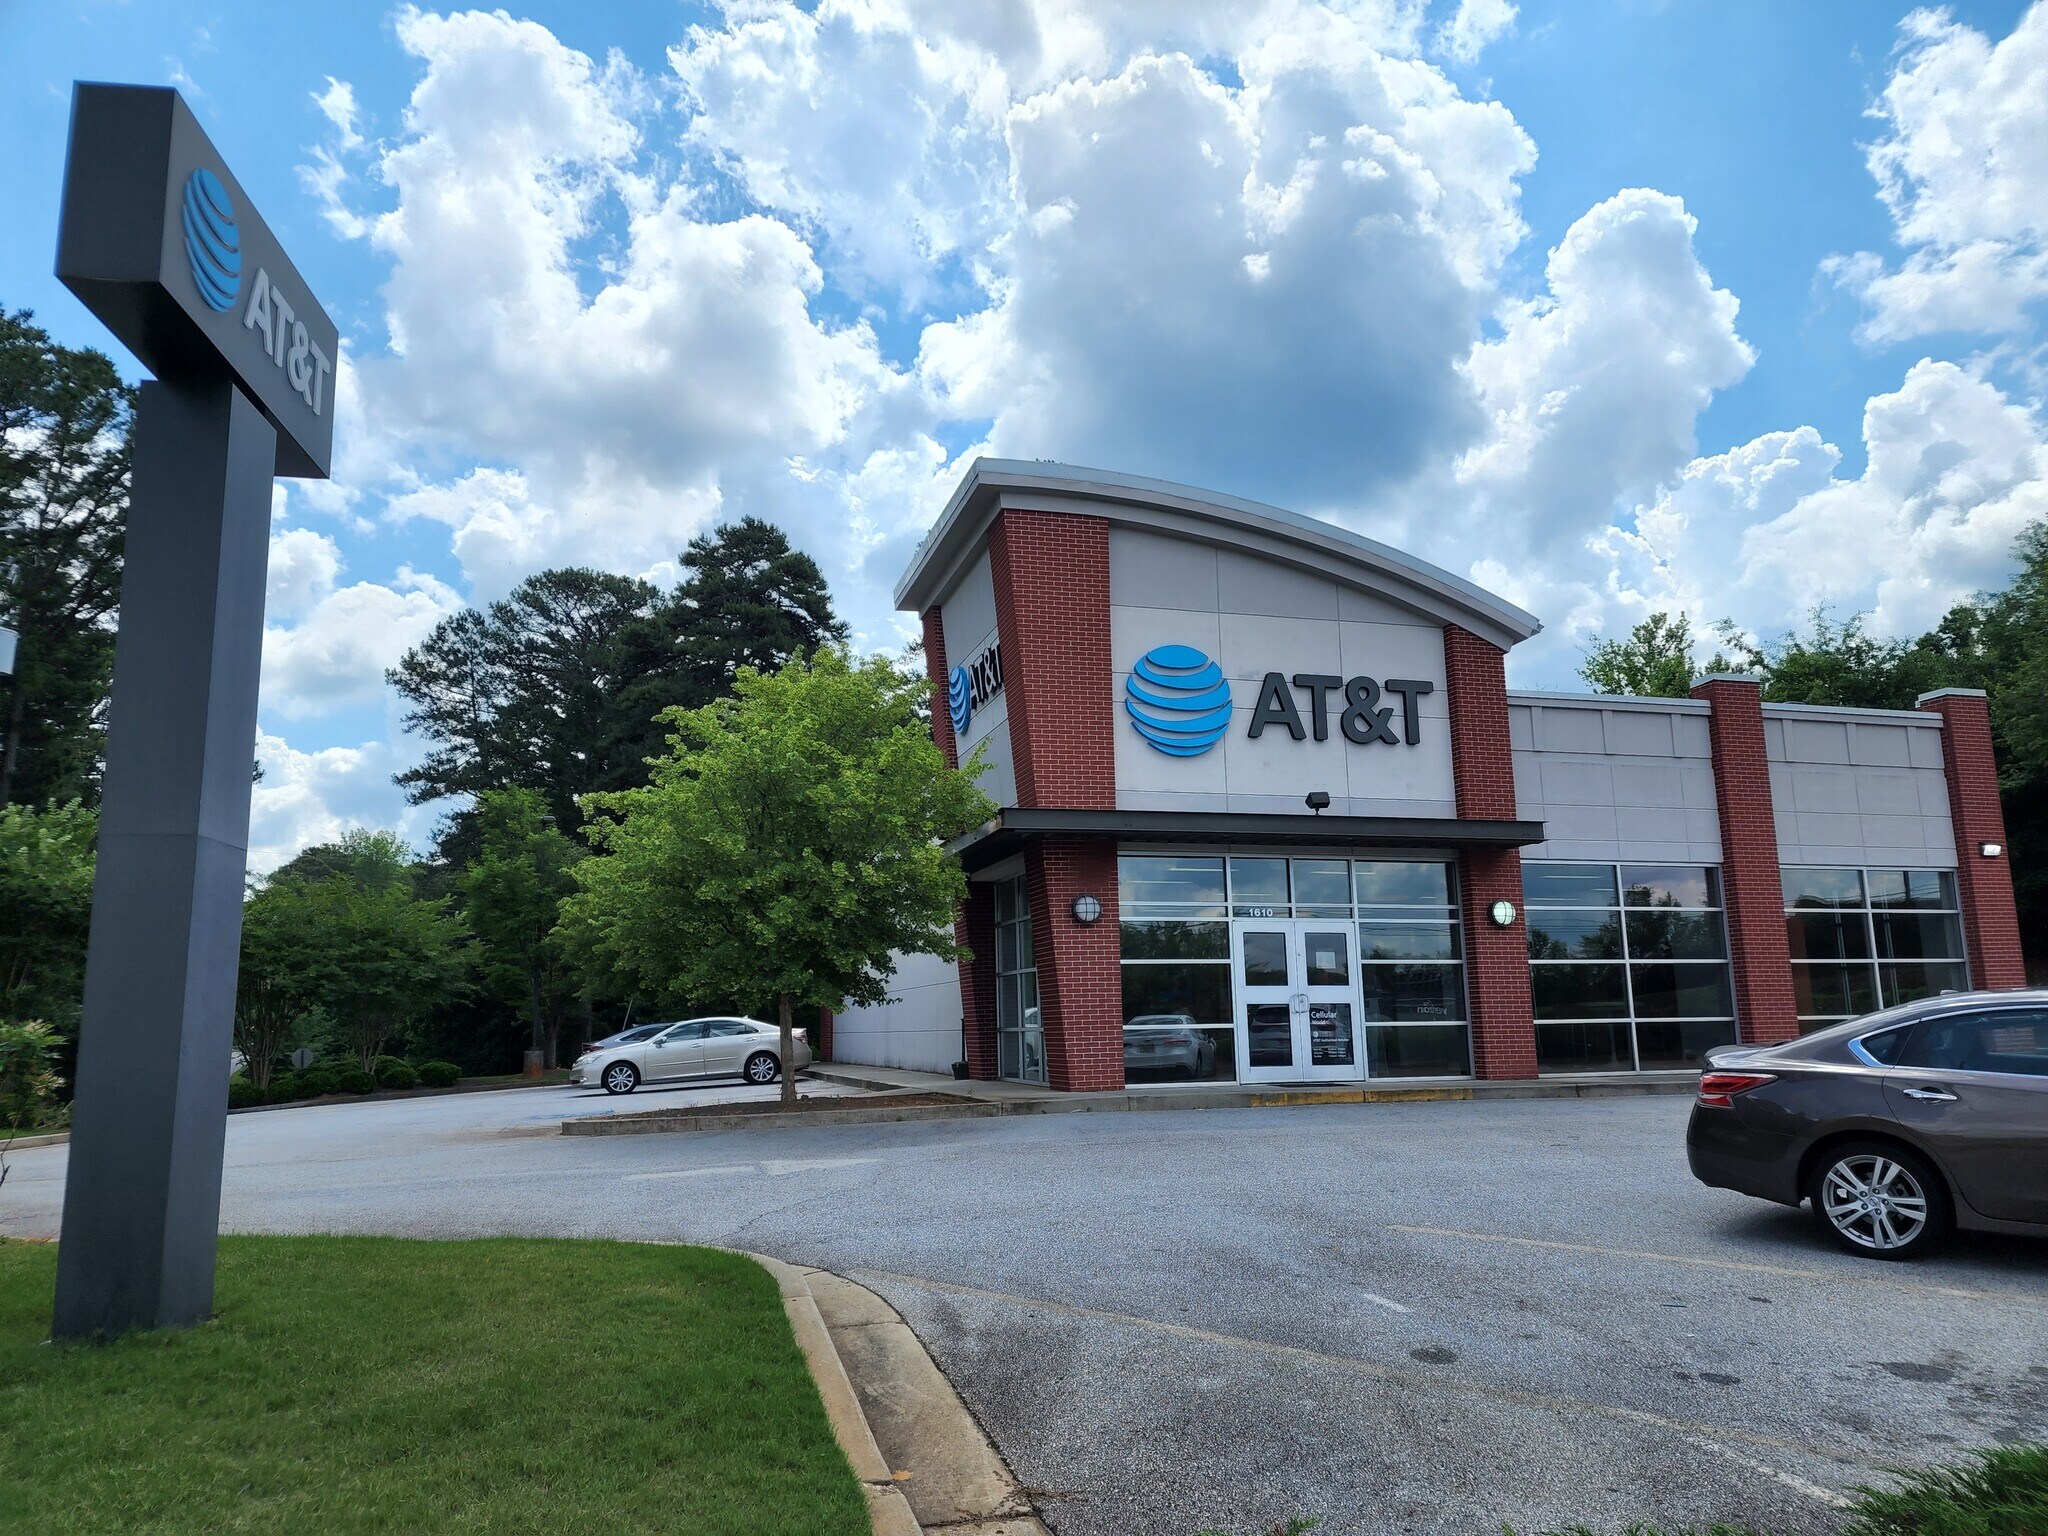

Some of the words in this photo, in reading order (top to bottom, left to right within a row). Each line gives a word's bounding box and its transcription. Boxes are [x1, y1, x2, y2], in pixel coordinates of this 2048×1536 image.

[243, 267, 331, 416] AT&T
[1247, 671, 1434, 746] AT&T
[1248, 908, 1273, 917] 1610
[1311, 1010, 1338, 1019] Cellular
